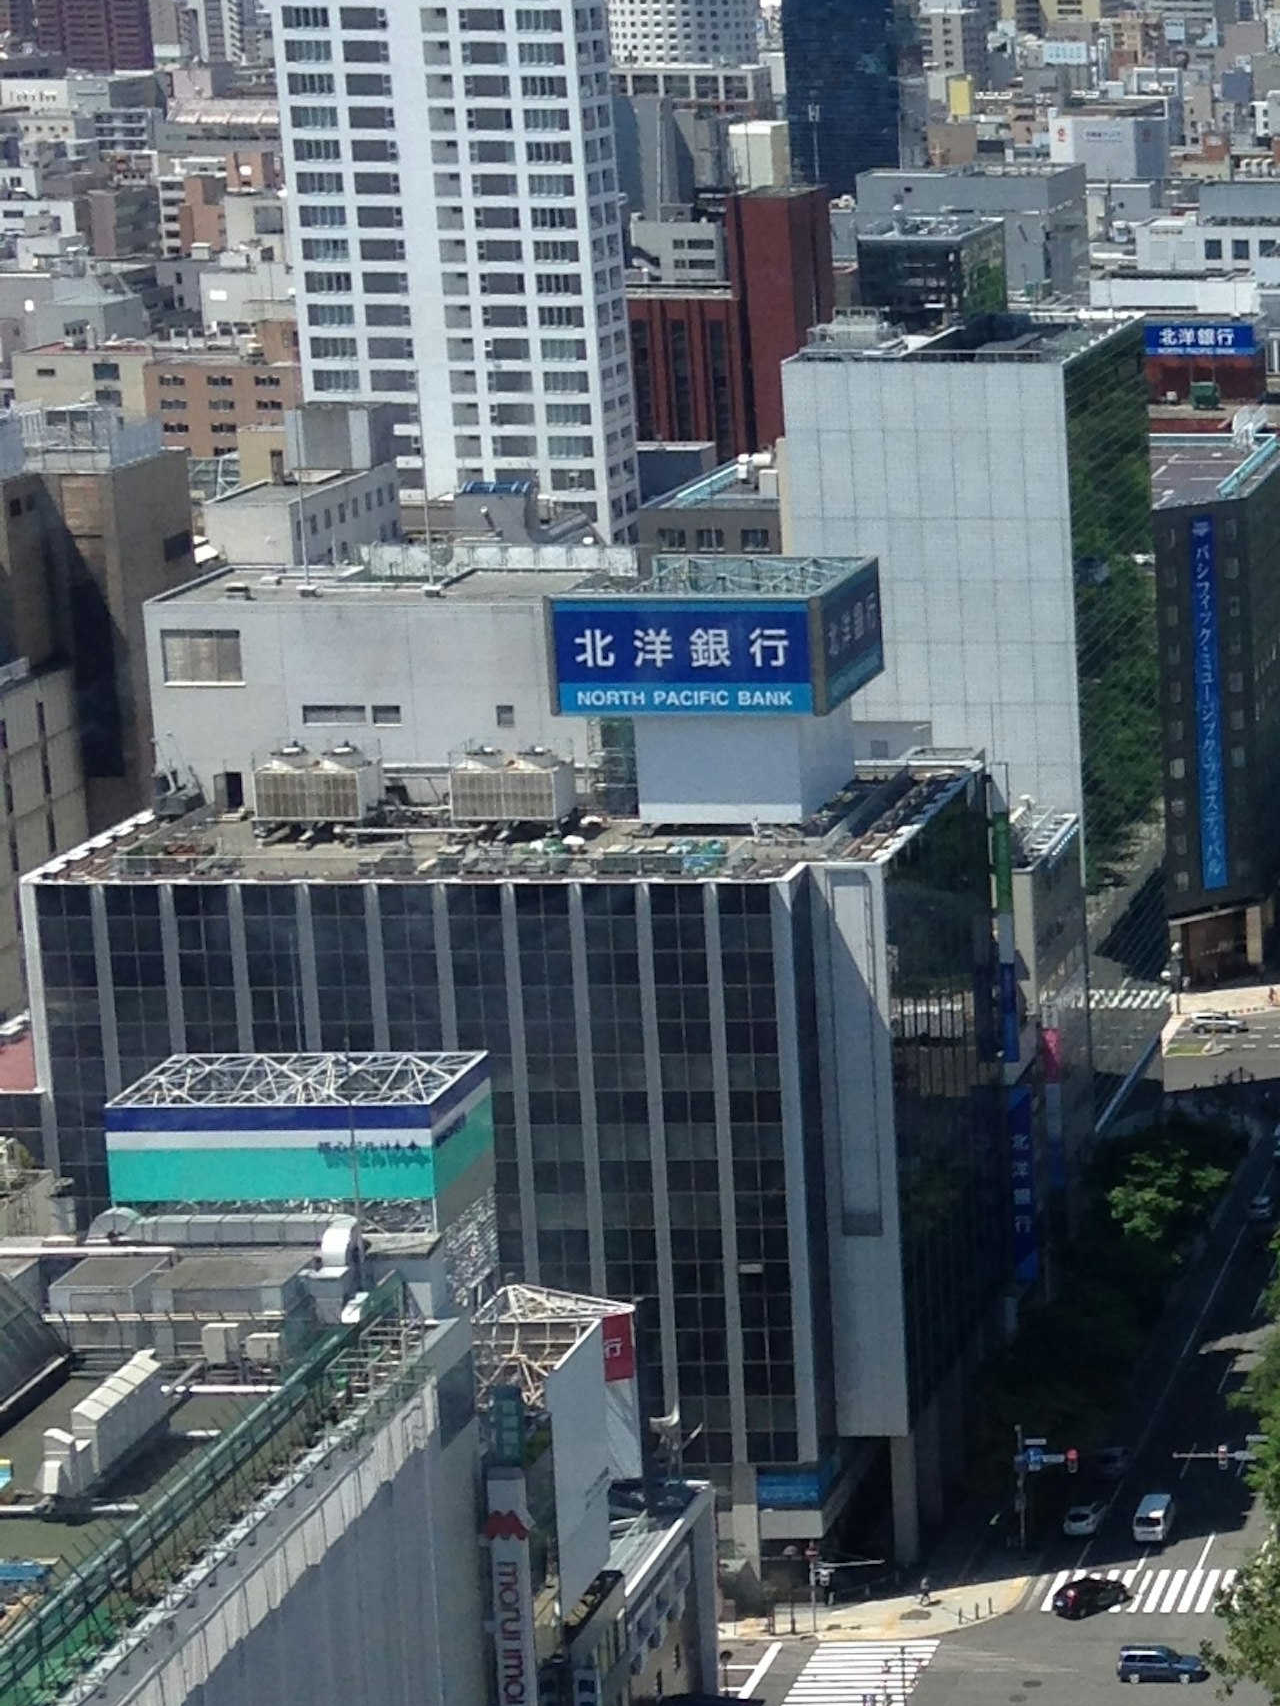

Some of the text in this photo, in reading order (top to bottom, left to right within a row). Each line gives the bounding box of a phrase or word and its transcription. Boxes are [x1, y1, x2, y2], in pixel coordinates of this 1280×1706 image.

[1159, 327, 1236, 346] 北洋銀行
[574, 627, 790, 668] 北洋銀行
[577, 690, 793, 706] NORTH PACIFIC BANK
[496, 1561, 522, 1642] marui
